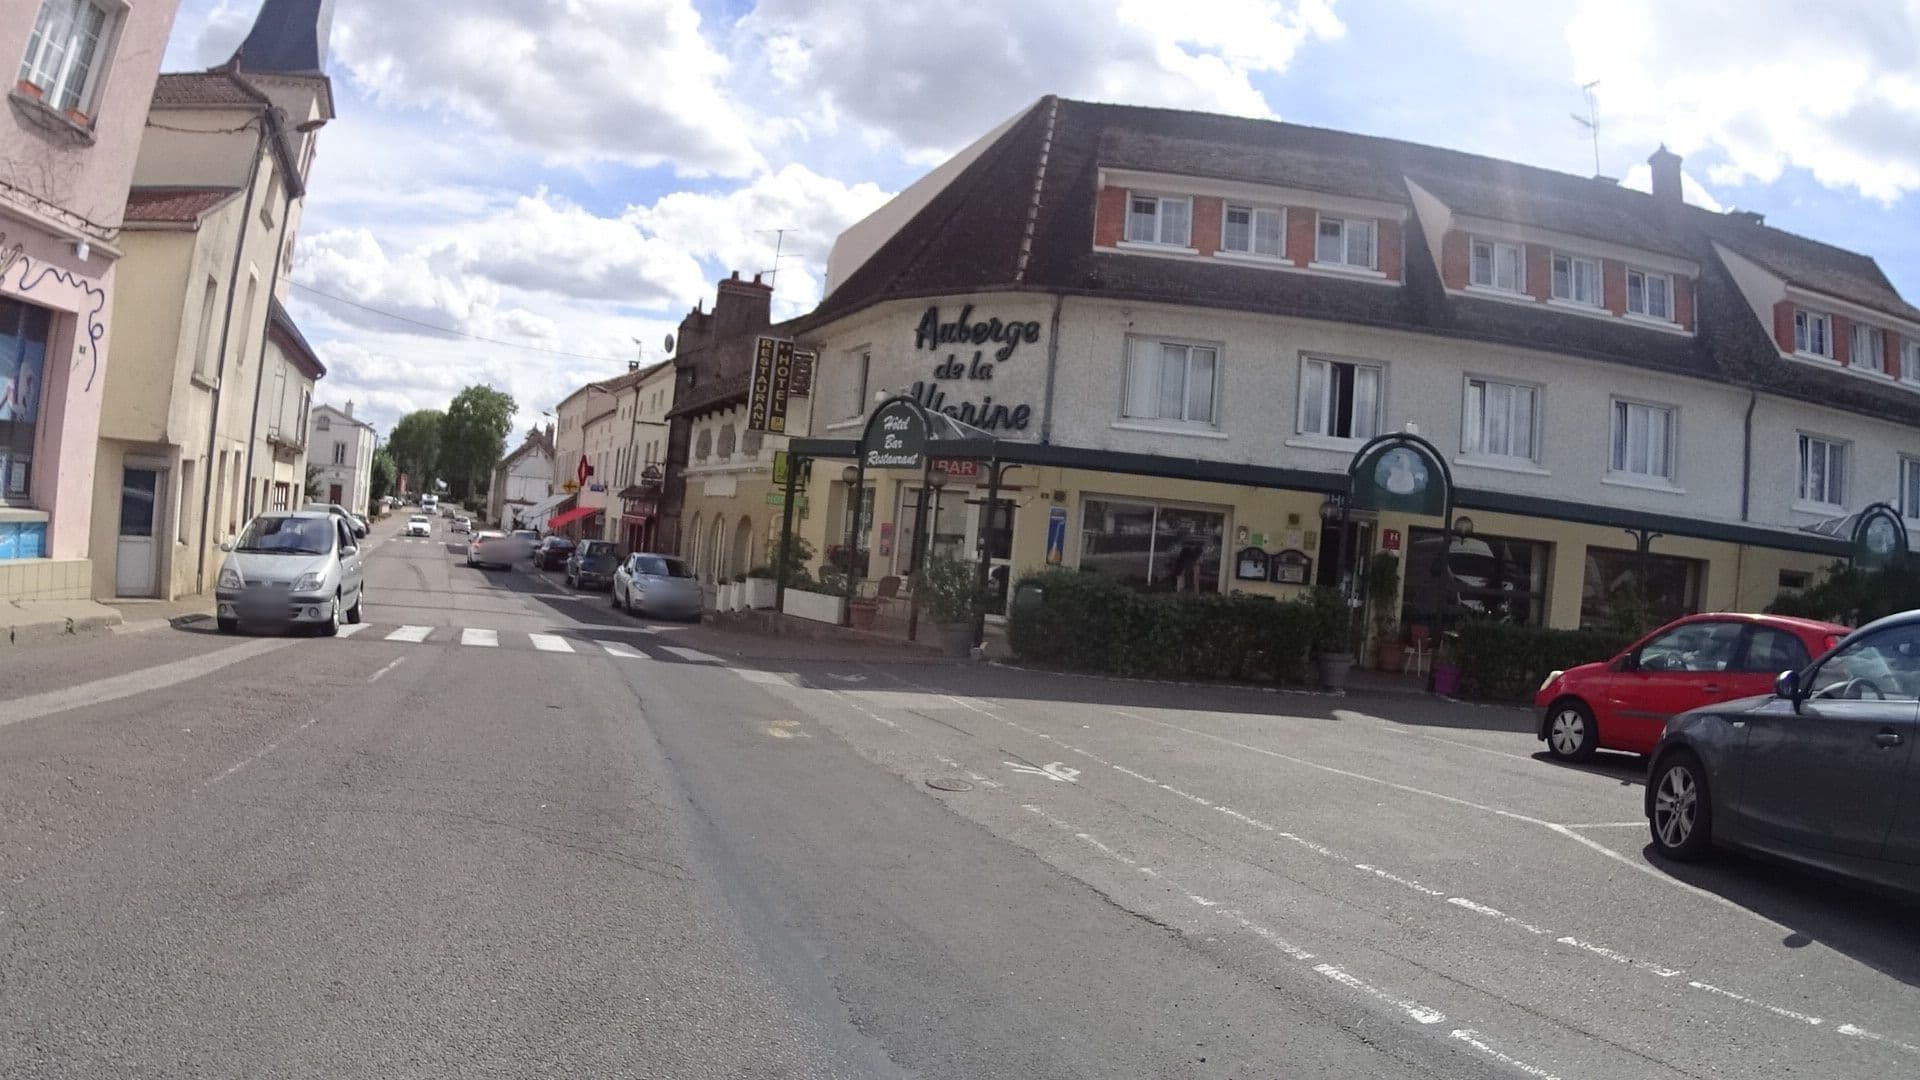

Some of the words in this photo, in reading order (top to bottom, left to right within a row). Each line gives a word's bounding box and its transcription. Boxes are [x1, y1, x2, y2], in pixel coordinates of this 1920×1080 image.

[914, 304, 1041, 362] Auberge
[933, 354, 965, 380] de
[967, 350, 994, 380] la
[753, 339, 773, 430] RESTAURANT
[773, 354, 790, 413] HOTEL
[883, 415, 911, 430] Hôtel
[883, 433, 904, 449] Bar
[866, 450, 919, 466] Restaurant
[937, 459, 973, 474] BAR
